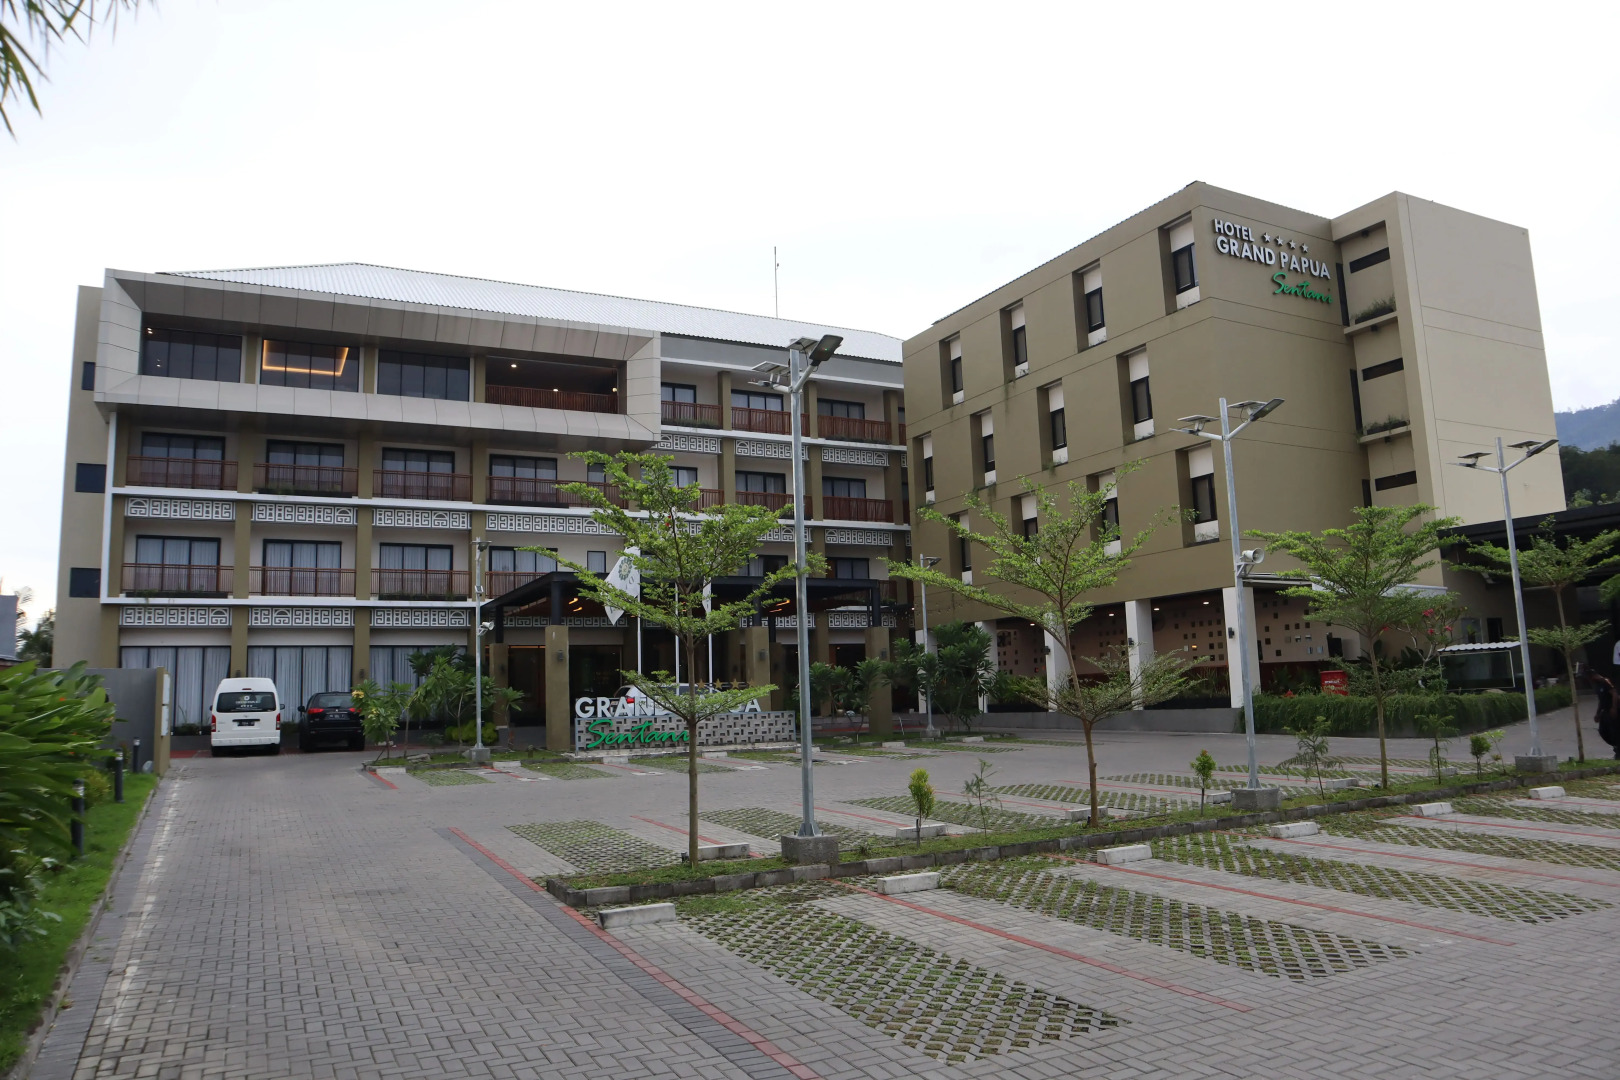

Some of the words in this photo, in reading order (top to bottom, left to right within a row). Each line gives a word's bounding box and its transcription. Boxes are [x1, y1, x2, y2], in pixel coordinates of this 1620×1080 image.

[1214, 218, 1255, 242] HOTEL
[1216, 235, 1276, 266] GRAND
[1280, 251, 1331, 280] PAPUA
[1272, 271, 1333, 304] Sentani
